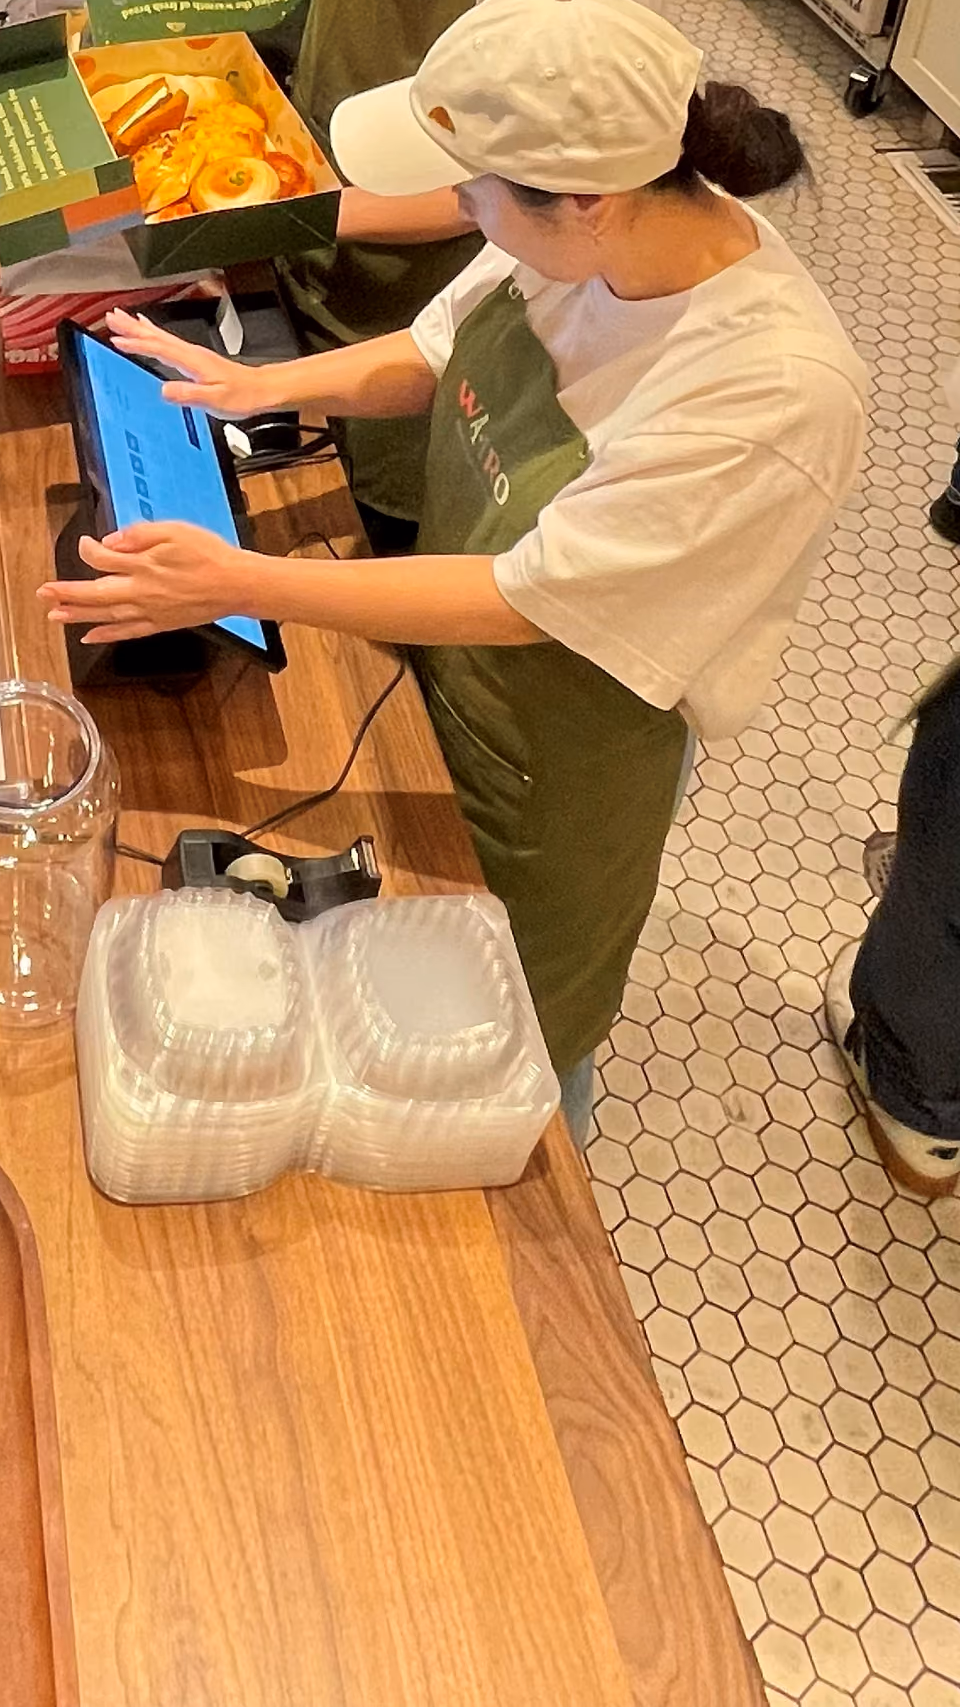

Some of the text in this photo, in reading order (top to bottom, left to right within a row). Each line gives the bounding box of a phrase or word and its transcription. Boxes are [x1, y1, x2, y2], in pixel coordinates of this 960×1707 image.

[152, 1, 177, 12] fresh
[179, 0, 191, 10] of
[192, 1, 234, 12] warmth
[234, 0, 252, 11] the
[121, 4, 151, 20] bread
